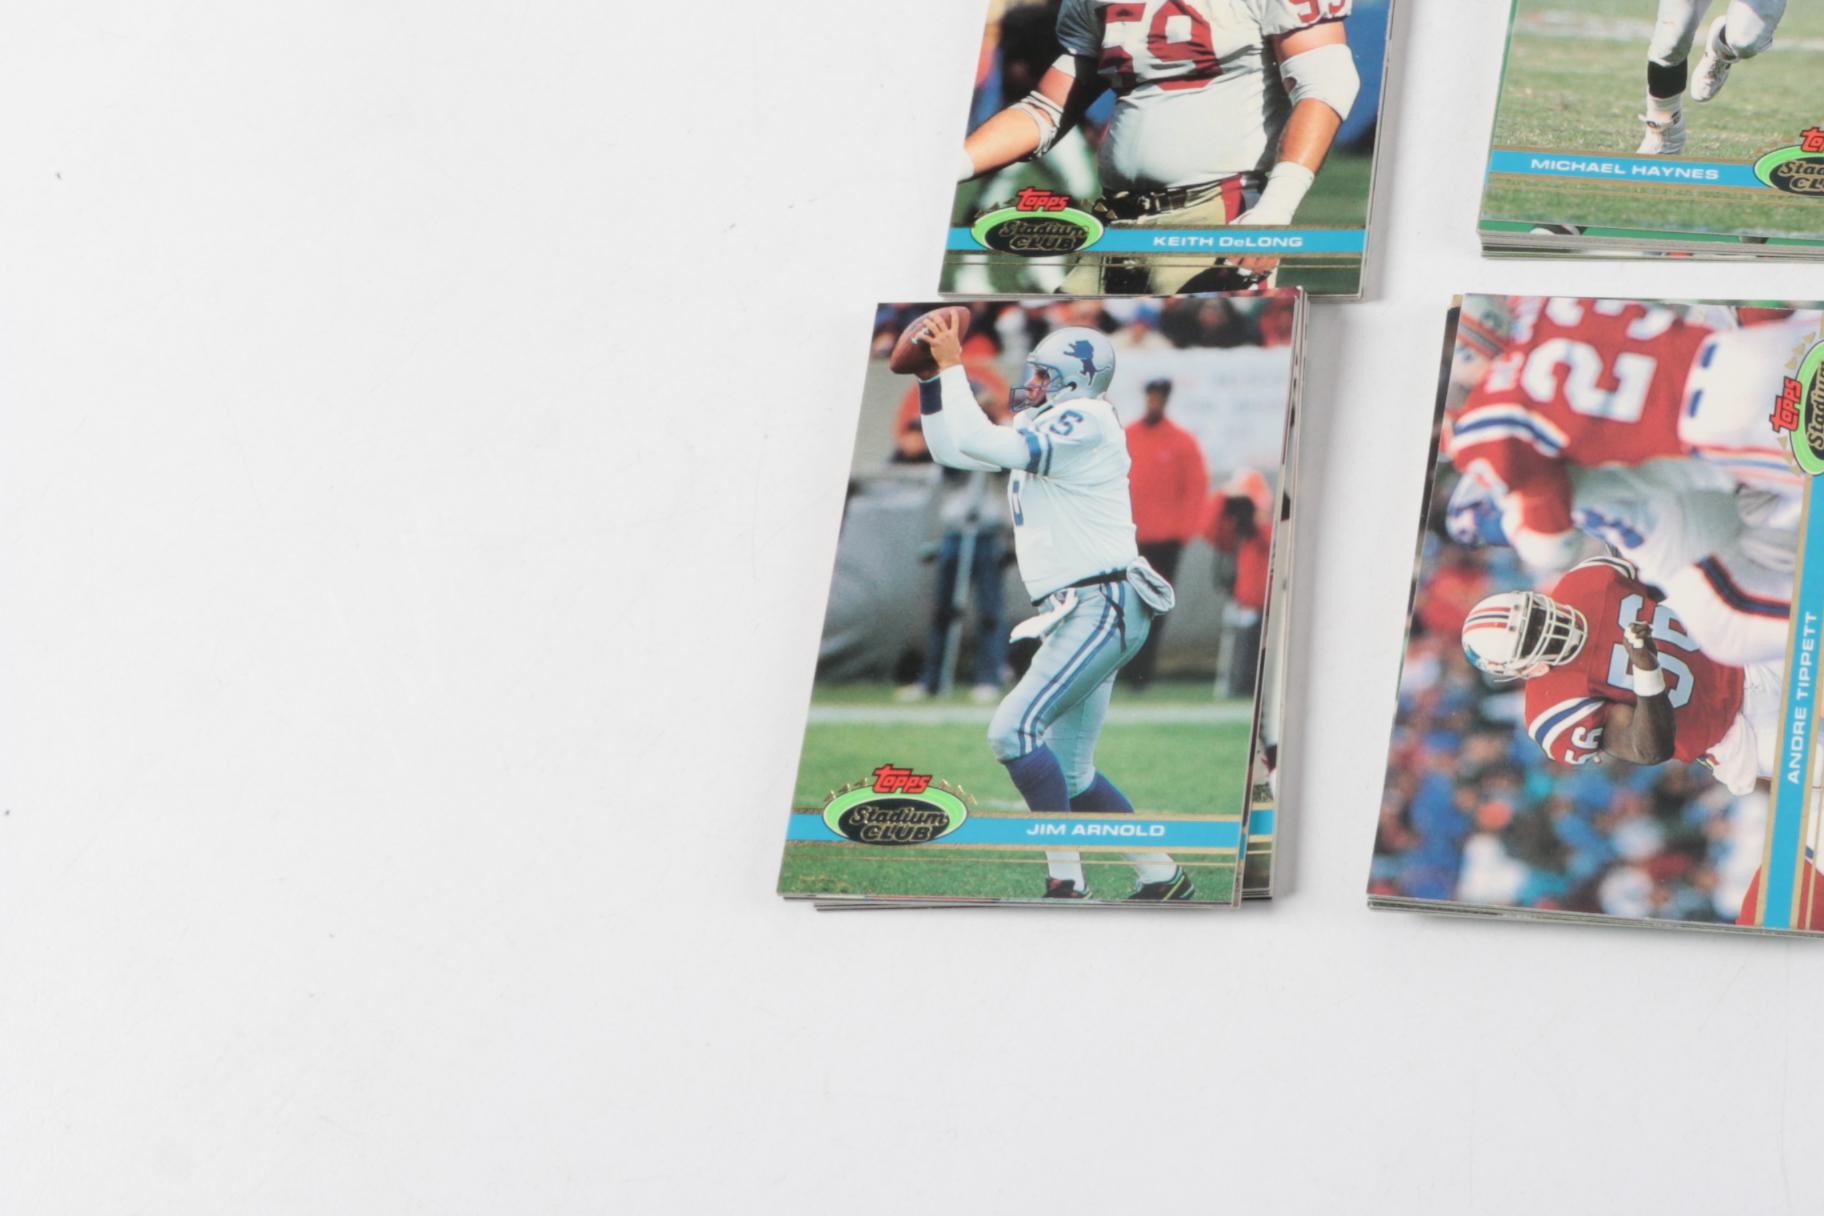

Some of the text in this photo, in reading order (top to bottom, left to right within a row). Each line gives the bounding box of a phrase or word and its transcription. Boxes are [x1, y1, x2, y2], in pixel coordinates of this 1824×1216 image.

[1530, 159, 1720, 180] MICHAEL HAYNES
[999, 220, 1090, 238] Stadium
[1009, 235, 1077, 251] CLUB
[1153, 236, 1303, 248] KEITH DeLONG
[1787, 611, 1818, 784] ANDRE TIPPETT
[850, 805, 950, 826] Stadium
[860, 824, 935, 842] CLUB
[1026, 823, 1167, 837] JIM ARNOLD
